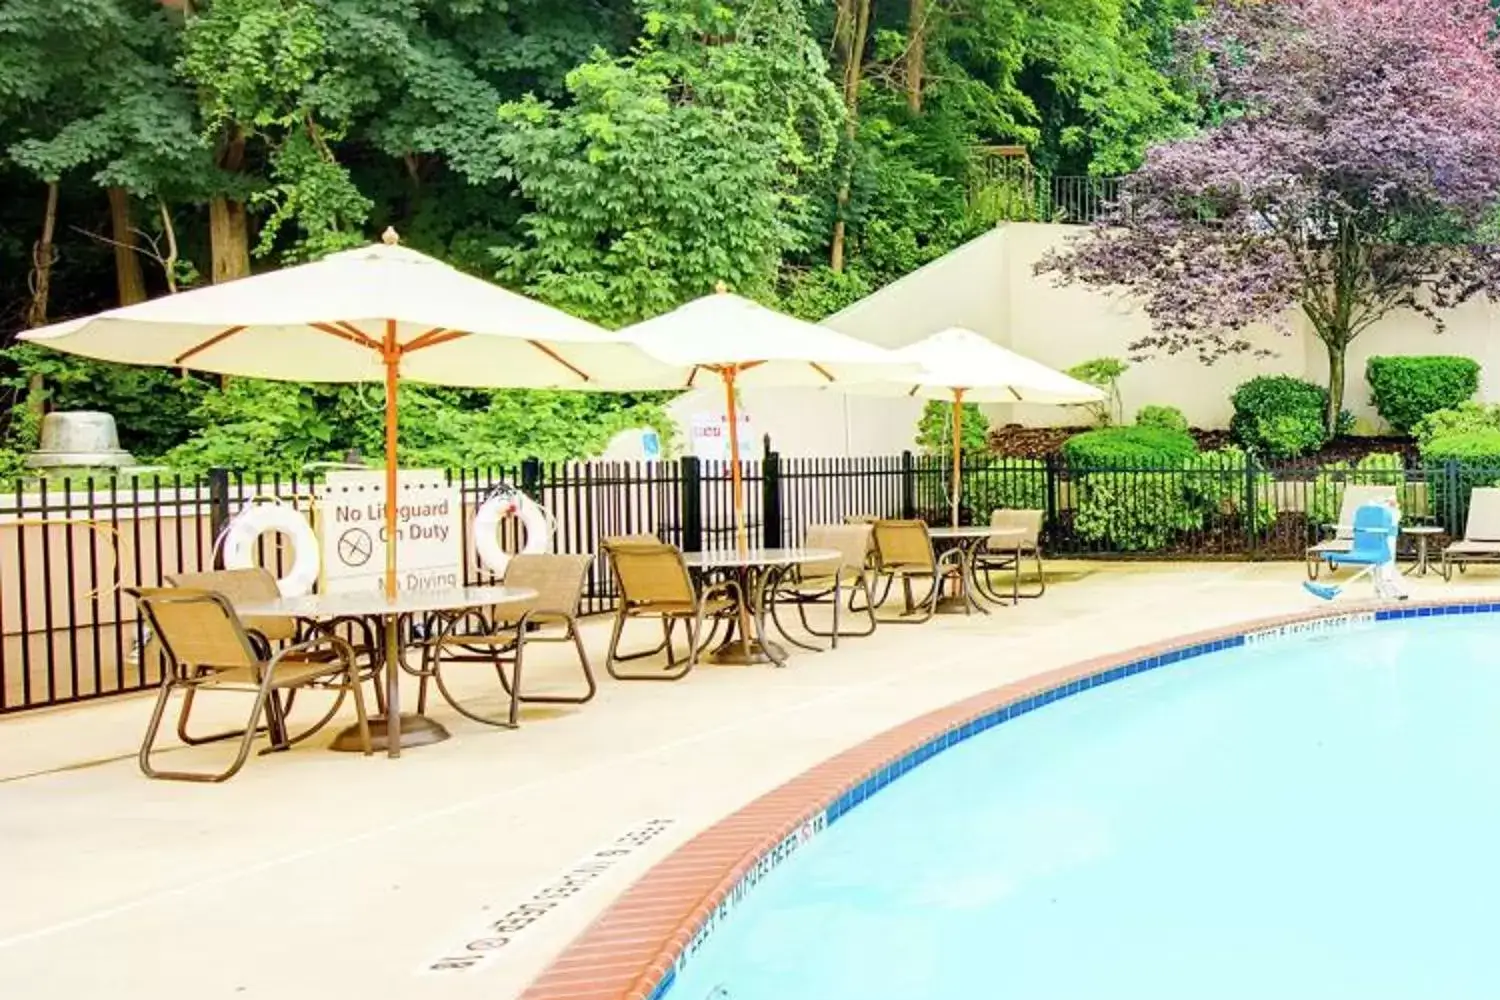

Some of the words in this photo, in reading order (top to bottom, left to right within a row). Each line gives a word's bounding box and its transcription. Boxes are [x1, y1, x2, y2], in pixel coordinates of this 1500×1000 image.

[336, 505, 361, 522] No
[368, 499, 449, 522] Lifguard
[409, 524, 449, 543] Duty
